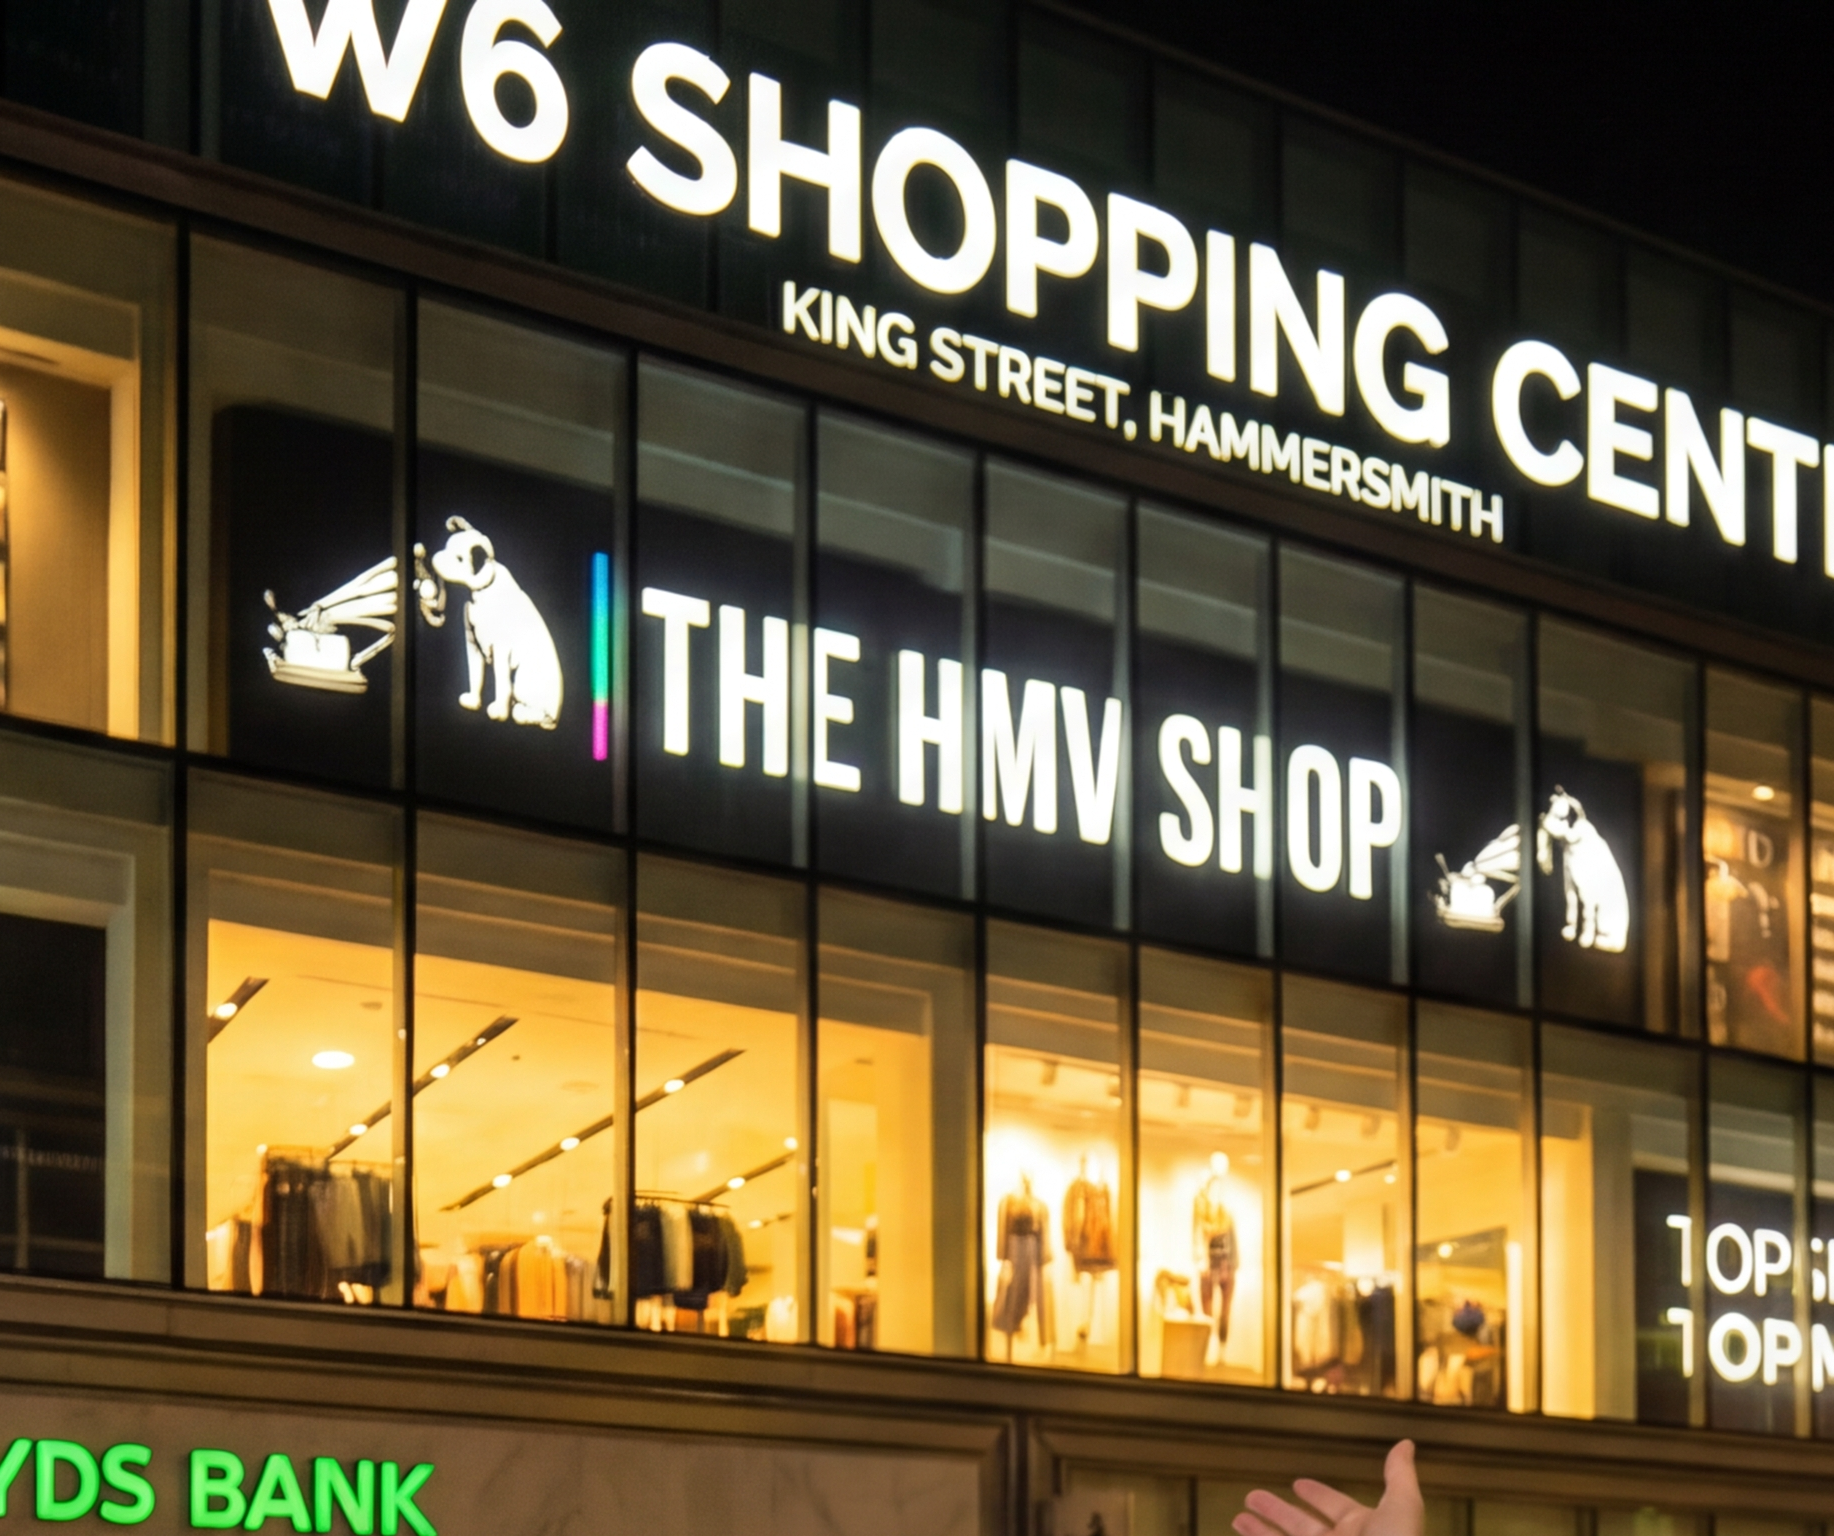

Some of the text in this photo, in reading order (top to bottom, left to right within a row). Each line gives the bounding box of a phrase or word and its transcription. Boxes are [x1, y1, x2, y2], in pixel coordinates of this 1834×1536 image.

[268, 0, 569, 163] W6
[626, 42, 1450, 448] SHOPPING
[783, 281, 1503, 542] KING STREET, HAMMERSMITH
[642, 587, 1403, 900] THE HMV SHOP
